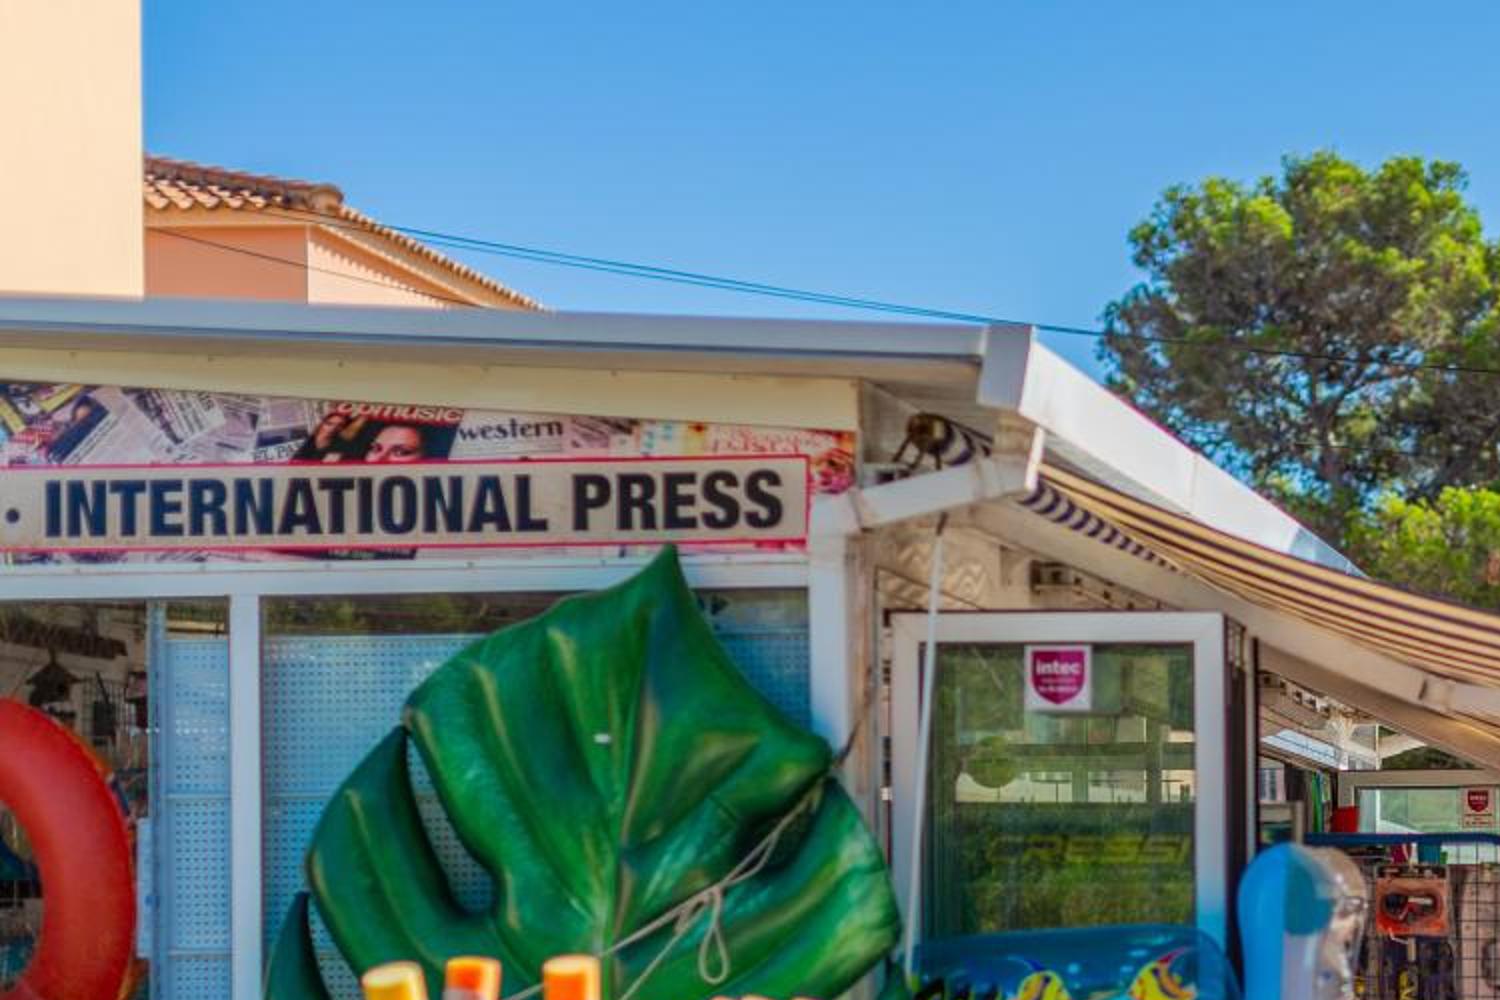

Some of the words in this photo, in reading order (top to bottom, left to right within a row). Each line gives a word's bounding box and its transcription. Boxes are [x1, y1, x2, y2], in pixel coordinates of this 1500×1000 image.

[459, 418, 563, 440] western
[44, 473, 549, 539] INTERNATIONAL
[572, 469, 784, 533] PRESS
